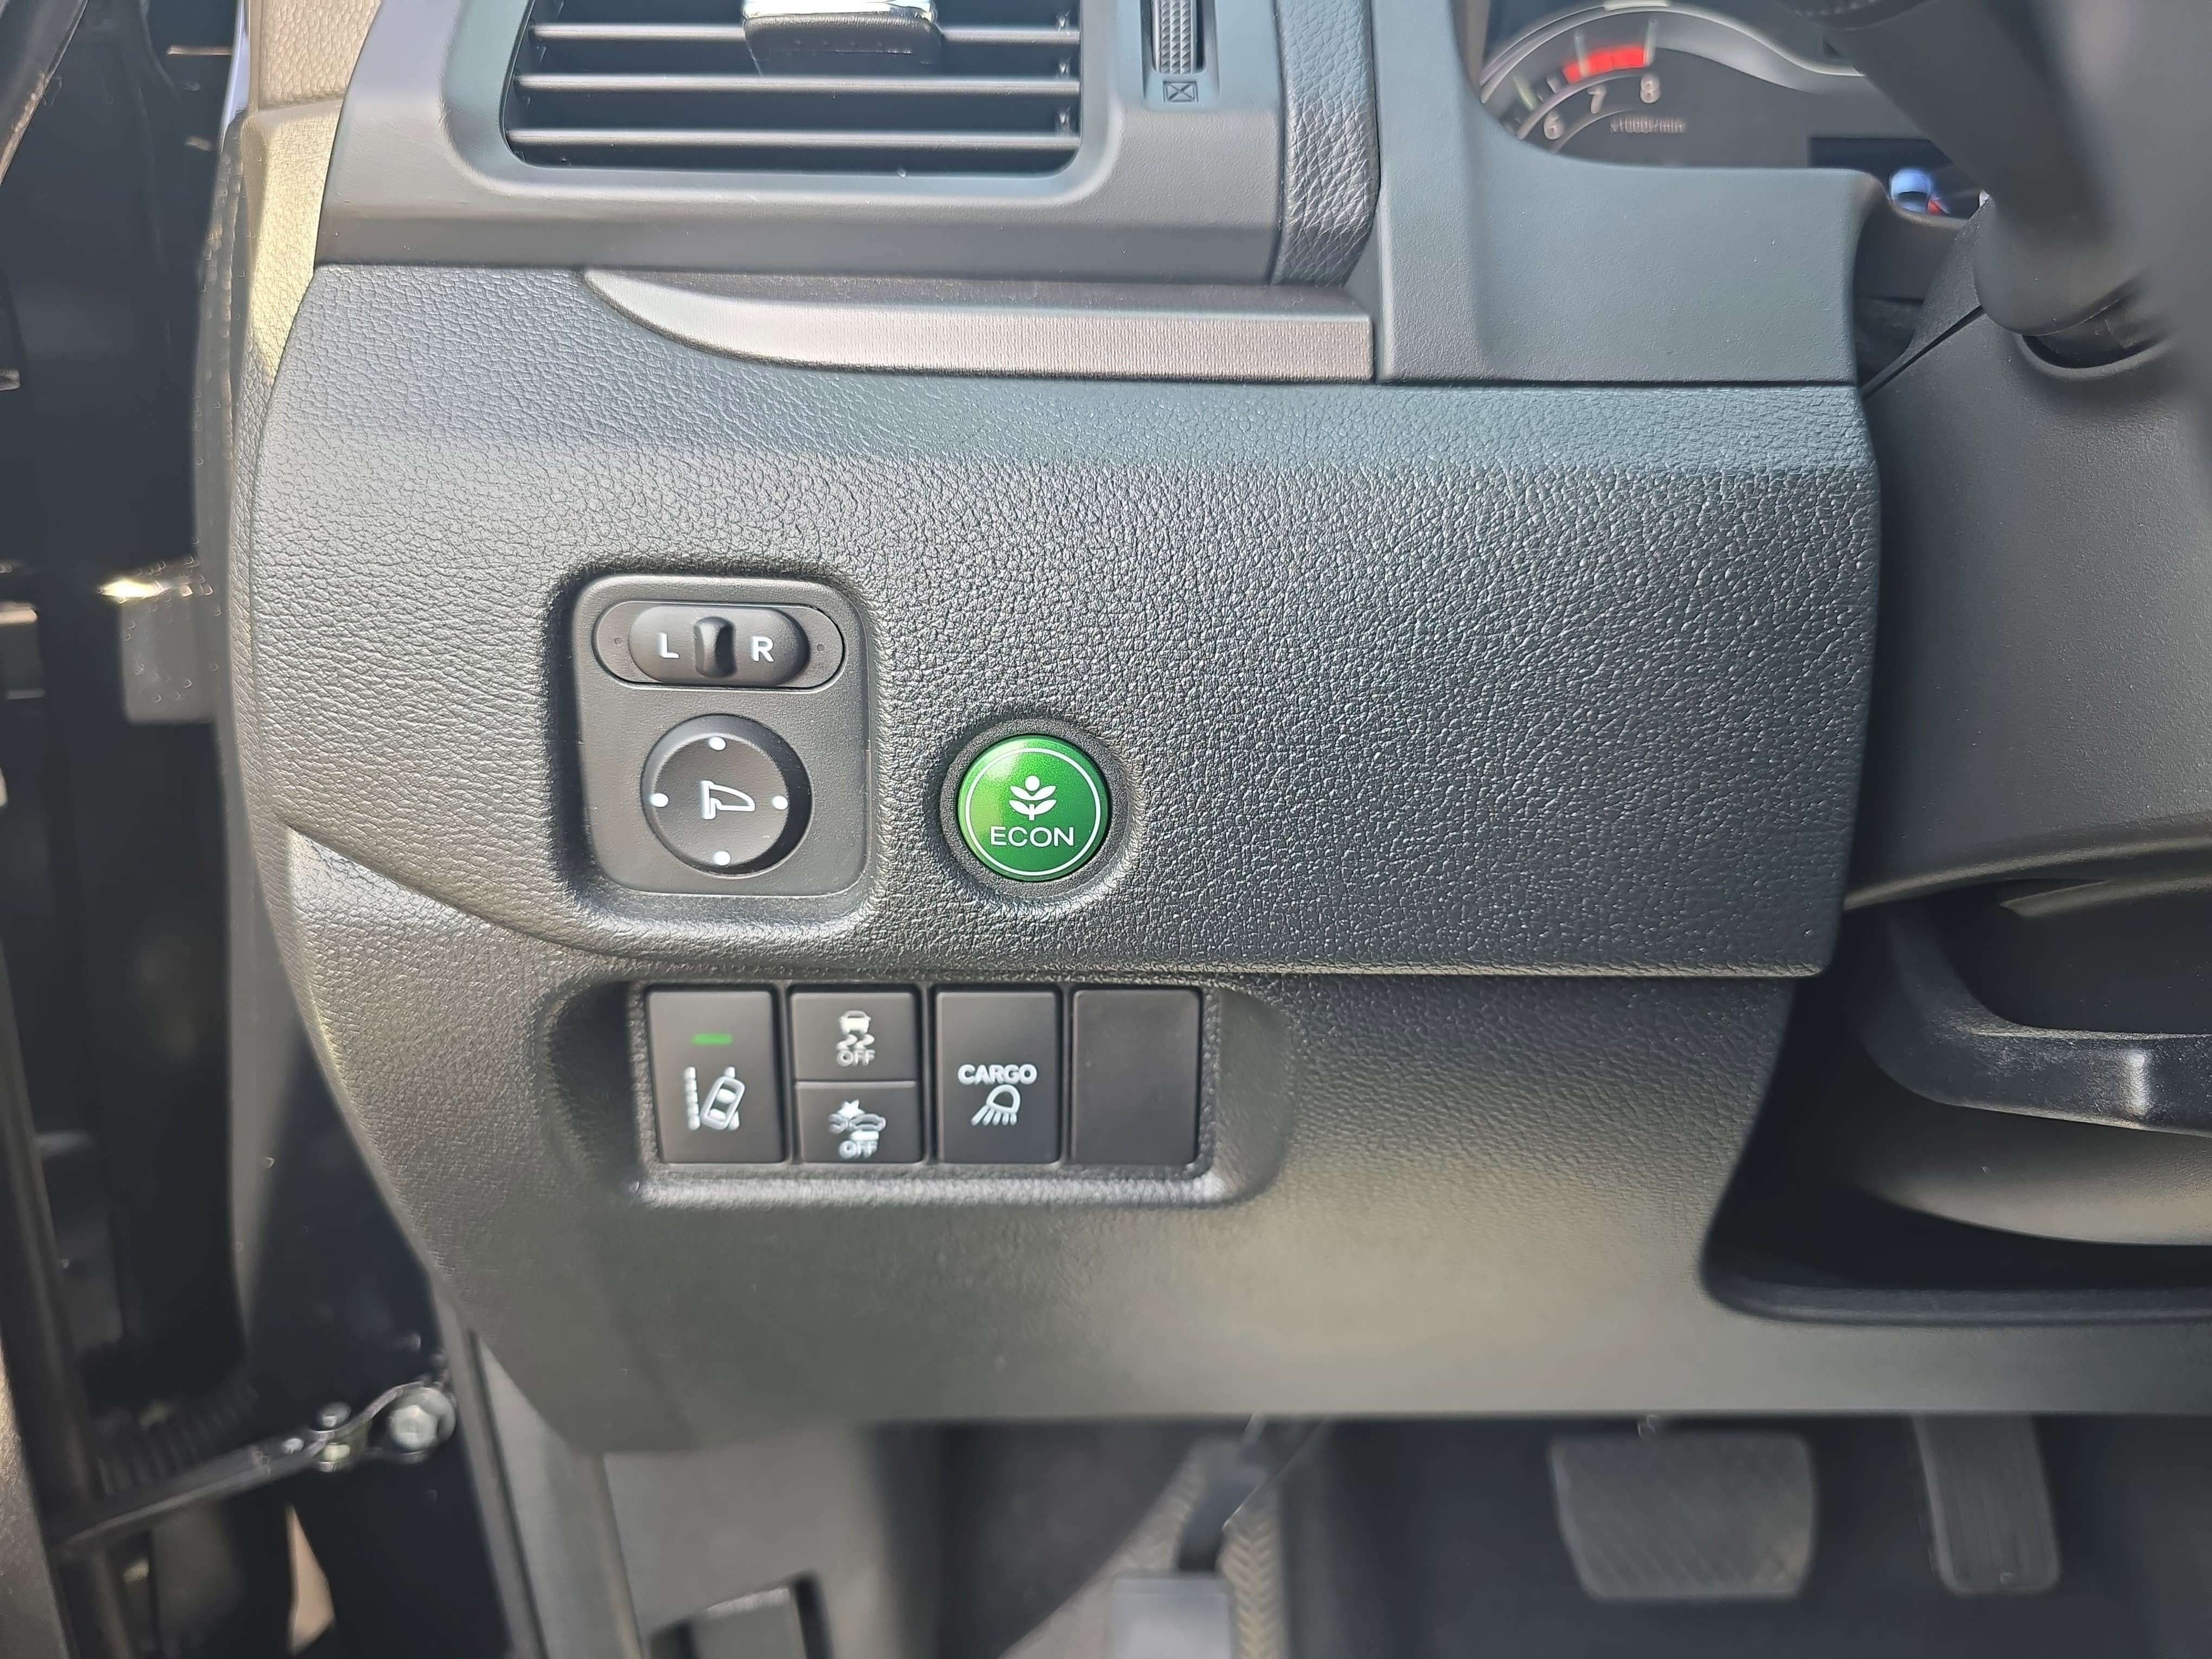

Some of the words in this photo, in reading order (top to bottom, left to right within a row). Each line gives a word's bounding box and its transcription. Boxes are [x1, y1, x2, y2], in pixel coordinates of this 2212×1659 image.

[1587, 85, 1606, 114] 7
[1639, 74, 1660, 104] 8
[1544, 111, 1565, 140] 6
[658, 633, 679, 658] L
[750, 636, 774, 662] R
[990, 826, 1074, 847] ECON
[837, 1049, 876, 1066] OFF
[957, 1064, 1038, 1084] CARGO
[839, 1140, 878, 1159] OFF
